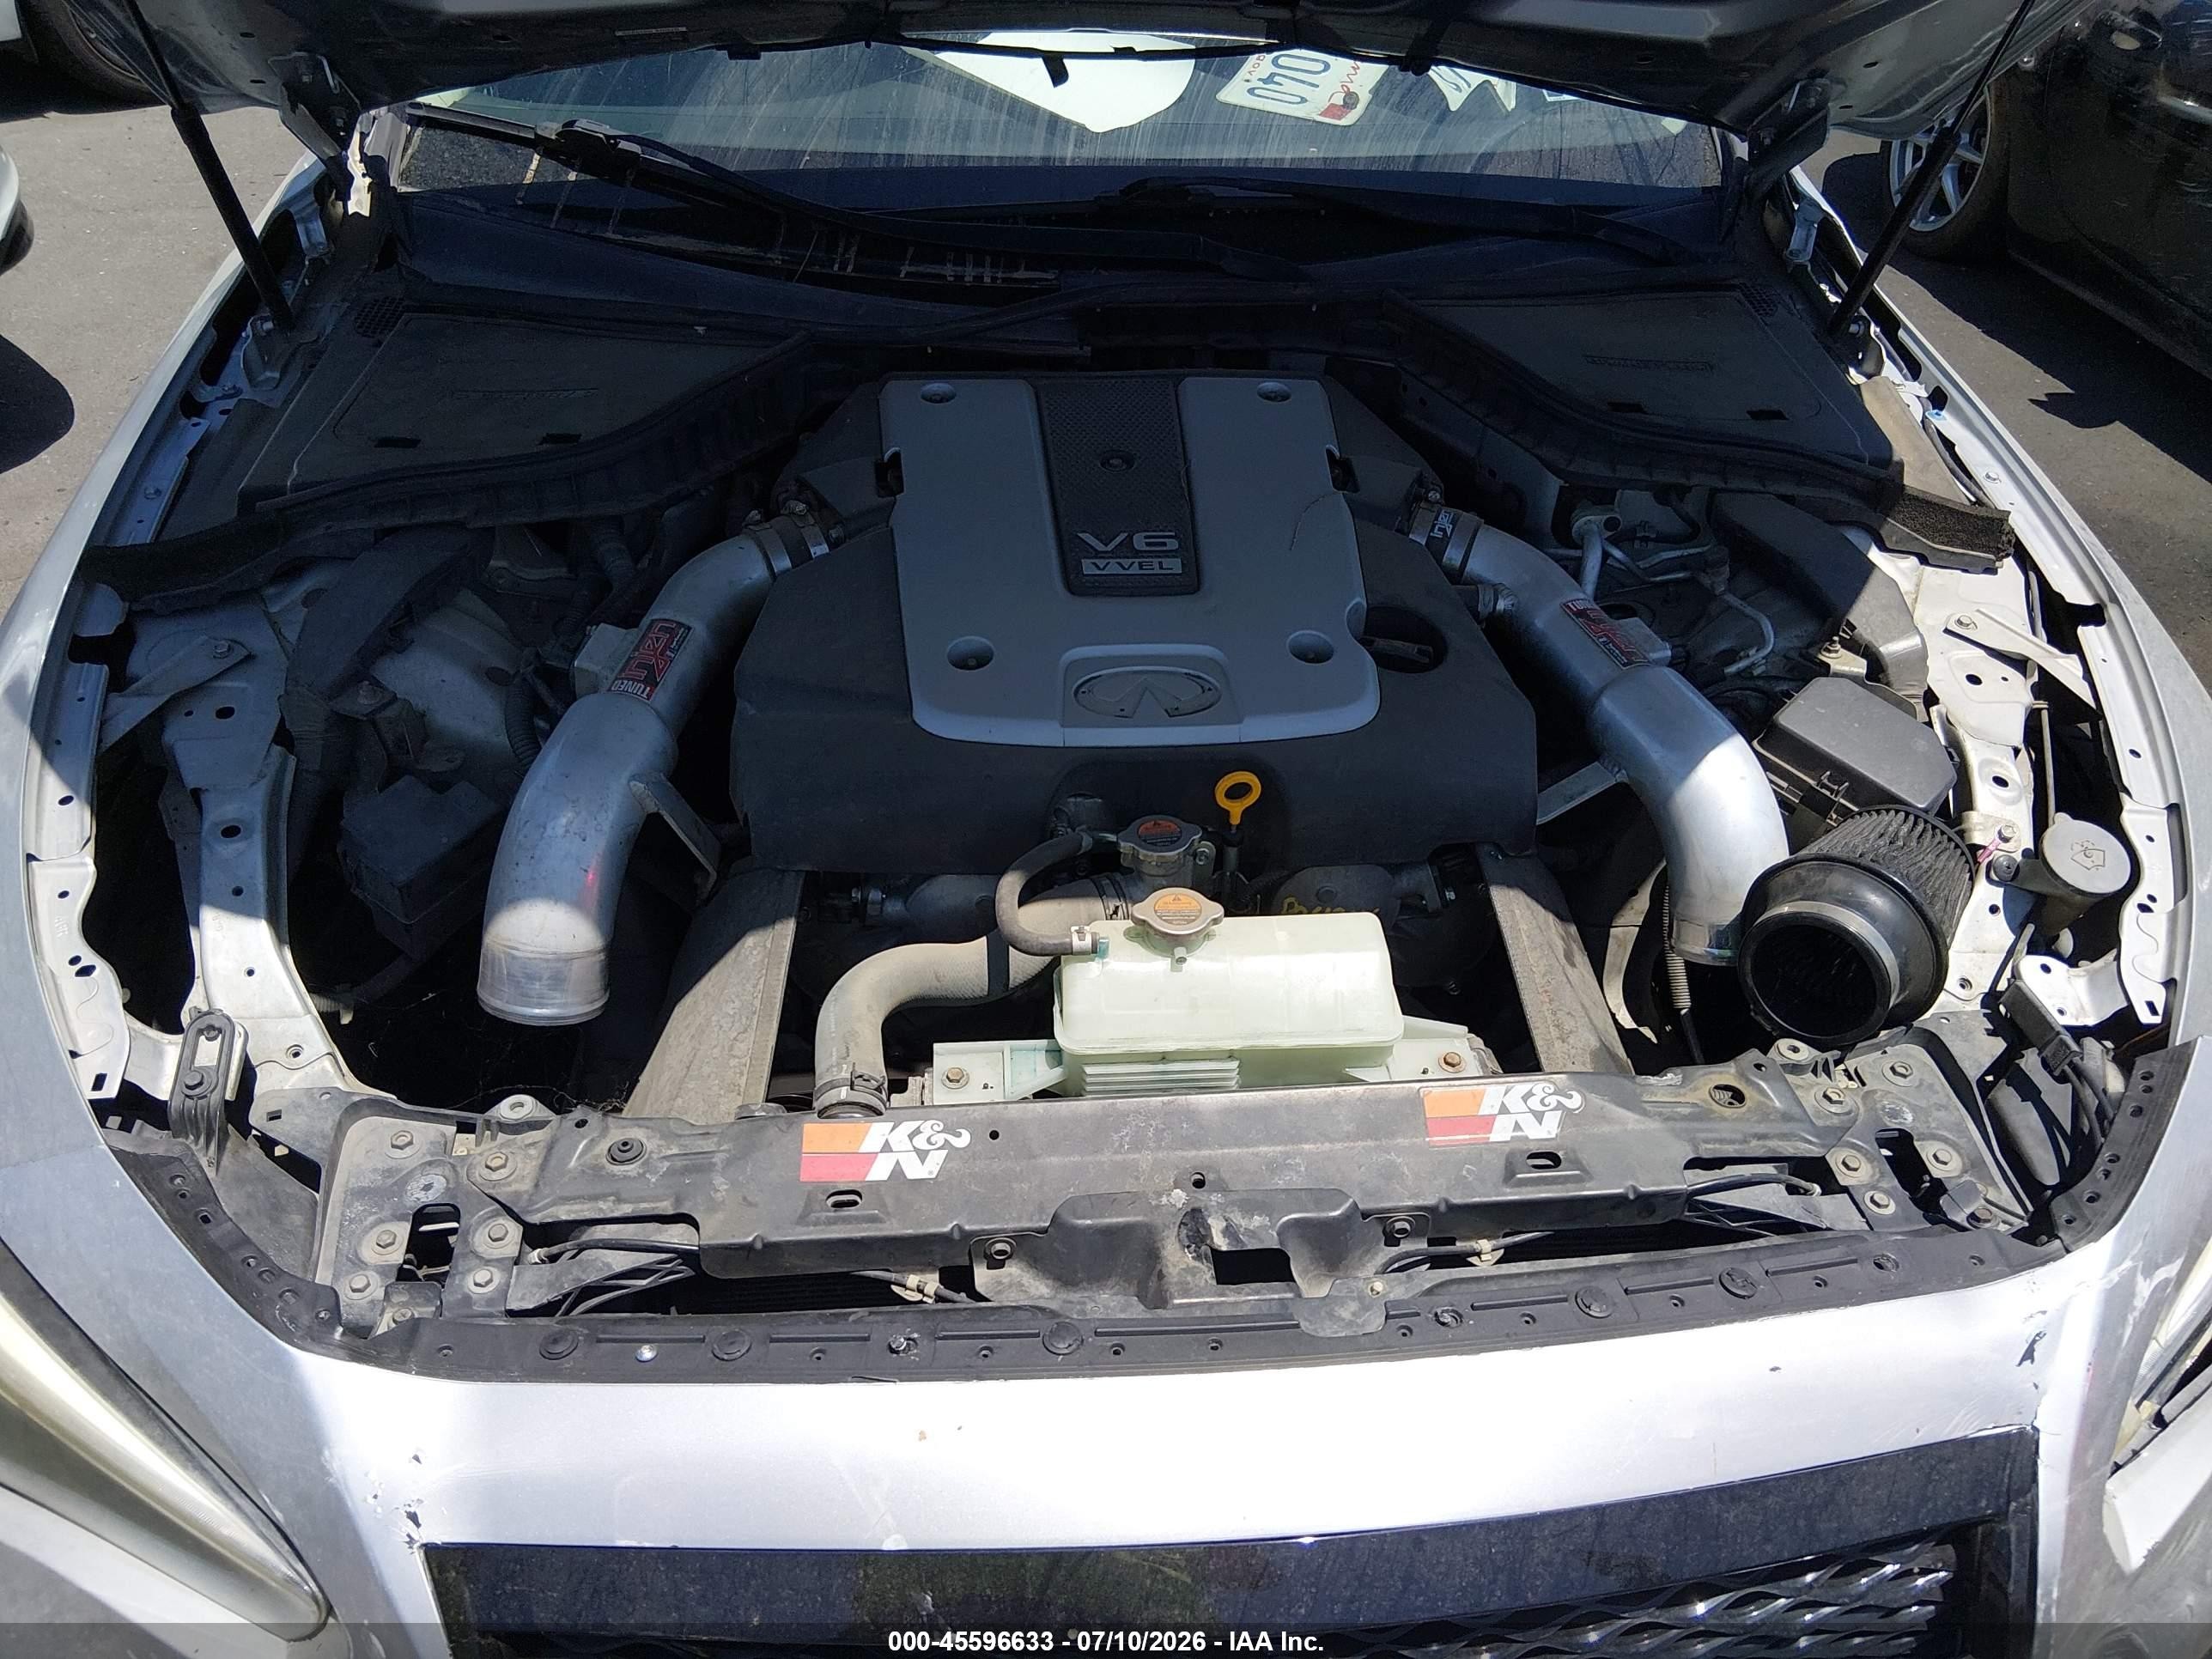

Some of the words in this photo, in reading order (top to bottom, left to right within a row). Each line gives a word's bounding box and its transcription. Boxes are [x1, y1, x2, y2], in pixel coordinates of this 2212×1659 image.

[1247, 53, 1331, 105] 040
[1077, 532, 1179, 551] V6
[1091, 560, 1174, 572] VVEL
[611, 679, 652, 699] TUNED
